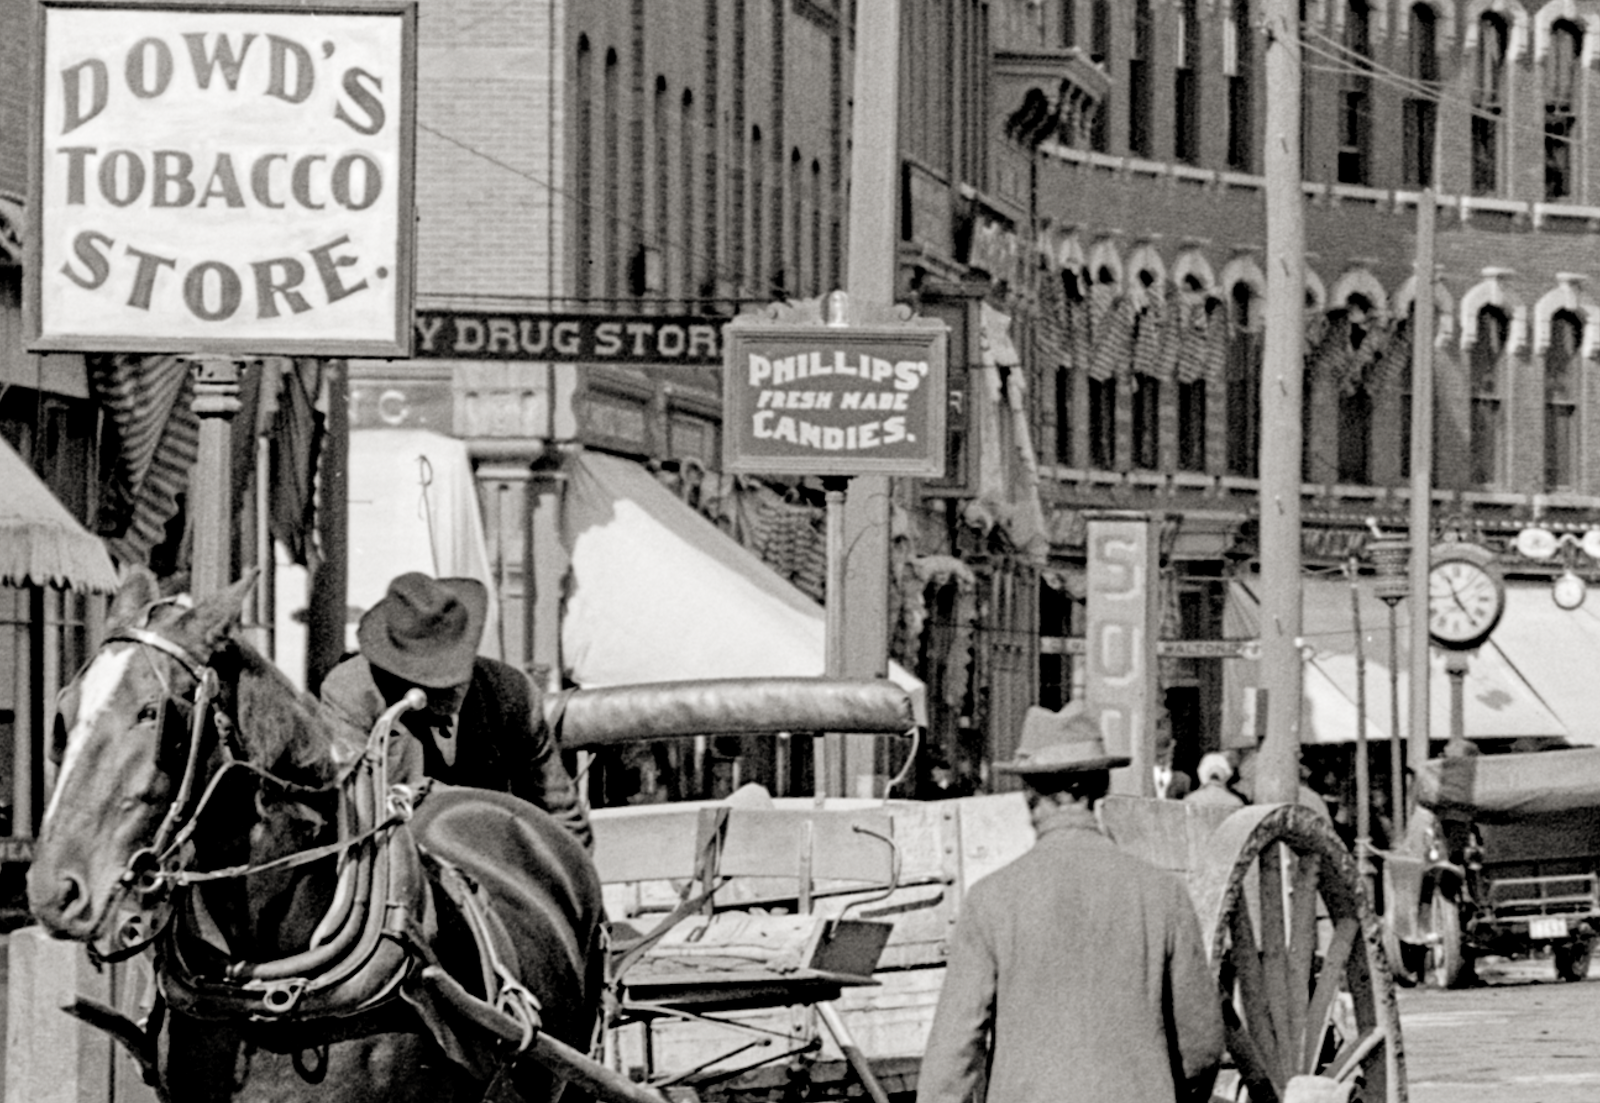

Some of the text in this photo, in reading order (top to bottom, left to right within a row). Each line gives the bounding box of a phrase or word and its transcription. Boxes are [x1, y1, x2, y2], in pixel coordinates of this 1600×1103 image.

[60, 32, 386, 136] DOWD'S
[57, 146, 383, 210] TOBACCO
[60, 229, 388, 321] STORE.
[454, 318, 580, 354] DRUG
[595, 323, 721, 356] STOR
[749, 351, 929, 390] PHILLIPS'
[756, 390, 910, 410] FRESH MADE
[752, 410, 917, 450] CANDIES.
